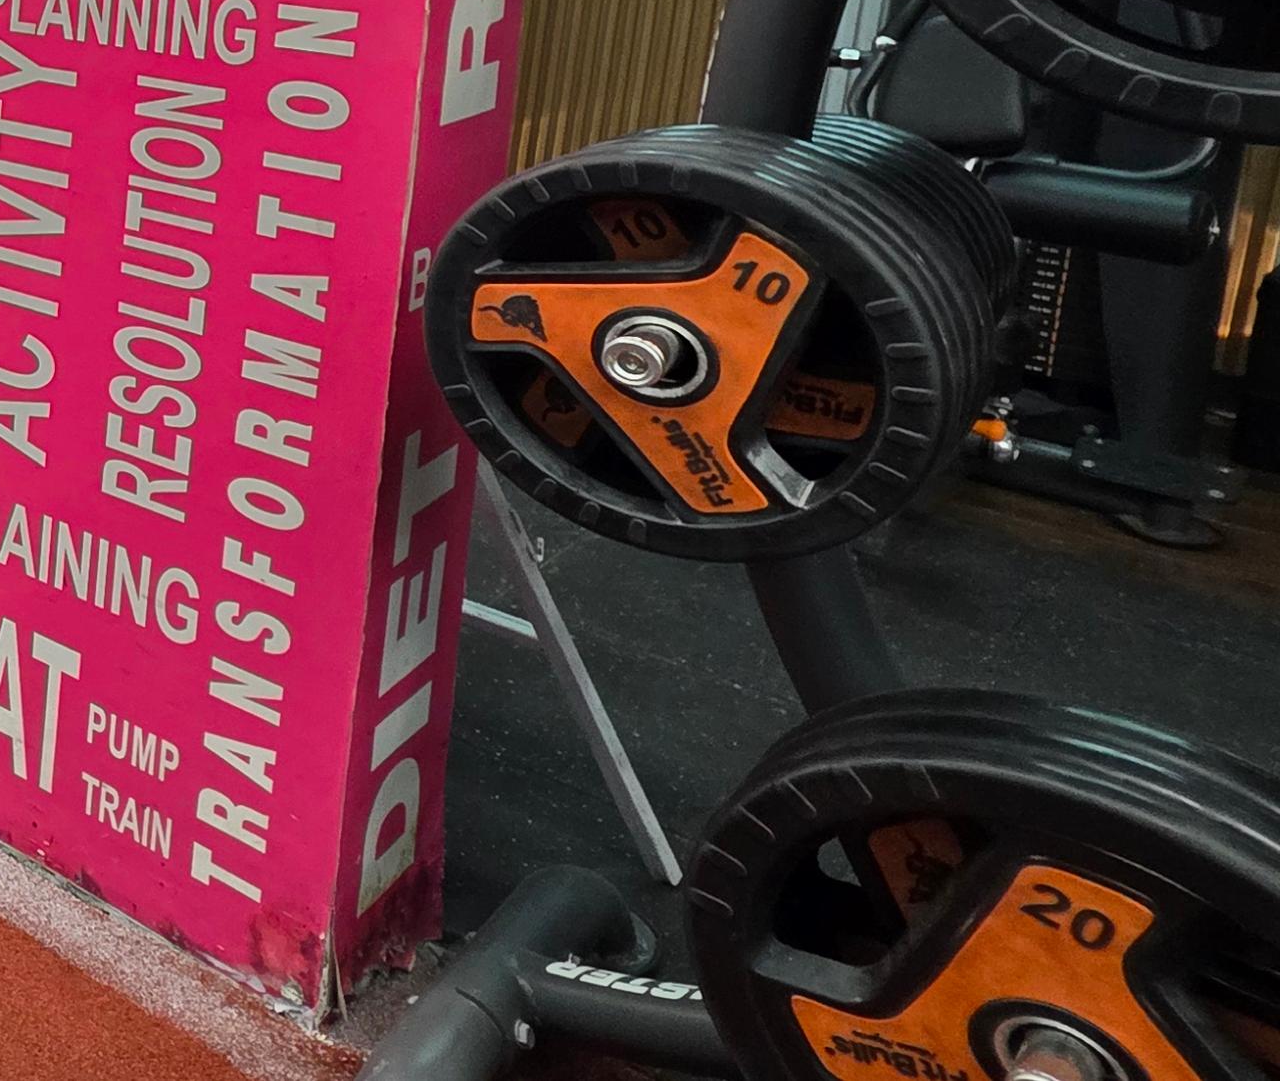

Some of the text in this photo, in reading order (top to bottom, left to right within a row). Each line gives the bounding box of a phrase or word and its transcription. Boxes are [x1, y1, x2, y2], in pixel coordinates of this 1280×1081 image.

[611, 210, 668, 250] 10
[101, 73, 228, 524] RESOLUTION
[731, 260, 791, 306] 10
[190, 3, 360, 904] TRANSFORMATION
[699, 473, 735, 508] Fit
[356, 428, 459, 919] DIET
[85, 702, 182, 783] PUMP
[80, 771, 174, 862] TRAIN
[1018, 883, 1117, 953] 20
[545, 961, 703, 1000] STER
